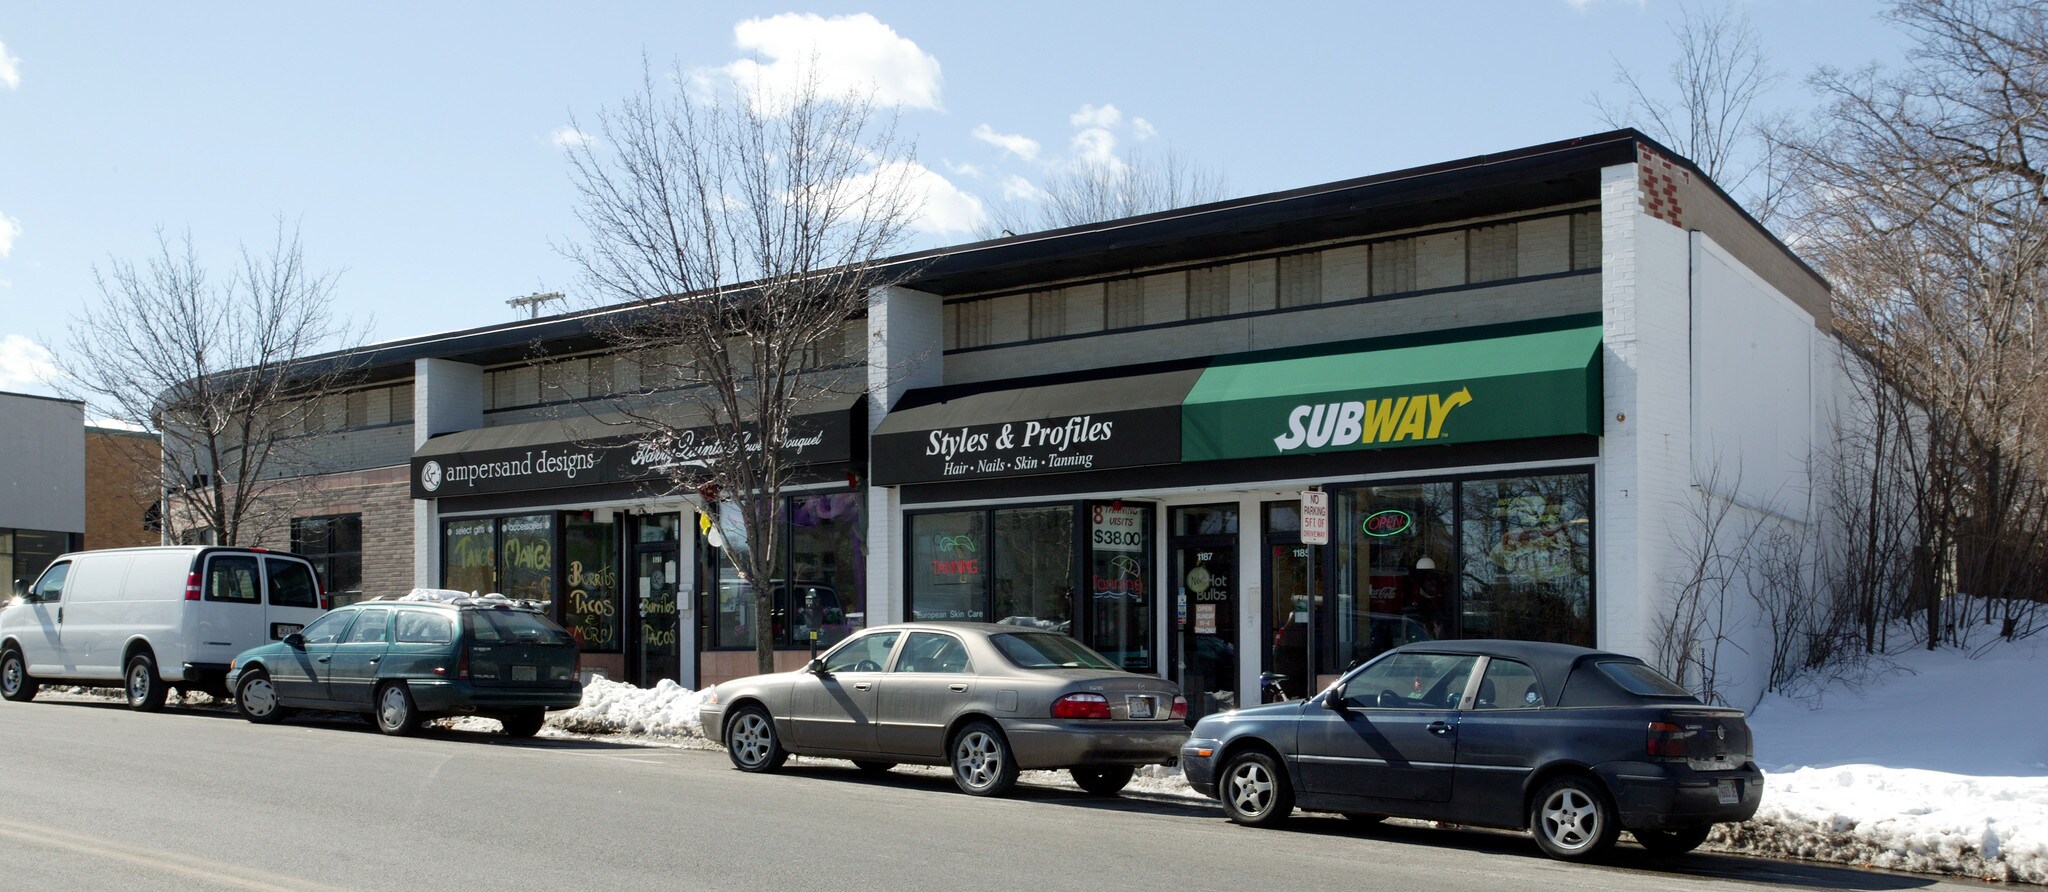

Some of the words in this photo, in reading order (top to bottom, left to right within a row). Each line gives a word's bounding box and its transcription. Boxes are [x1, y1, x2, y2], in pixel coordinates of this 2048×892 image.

[1274, 386, 1472, 452] SUBWAY
[926, 427, 989, 461] Styles
[995, 423, 1014, 450] &
[1021, 416, 1113, 451] Profiles
[446, 452, 532, 487] ampersand
[536, 450, 594, 478] designs
[943, 462, 969, 476] Hair
[976, 458, 1005, 474] Nails
[1014, 456, 1038, 471] Skin
[1048, 453, 1093, 468] Tanning
[1310, 495, 1319, 504] NO
[1094, 505, 1103, 525] 8
[1303, 506, 1326, 516] PARKING
[1369, 516, 1403, 530] OPEN
[1094, 529, 1141, 546] $38.00
[1197, 552, 1213, 560] 1187
[932, 559, 978, 574] TANNING
[949, 610, 964, 618] Skin
[967, 609, 983, 618] Care
